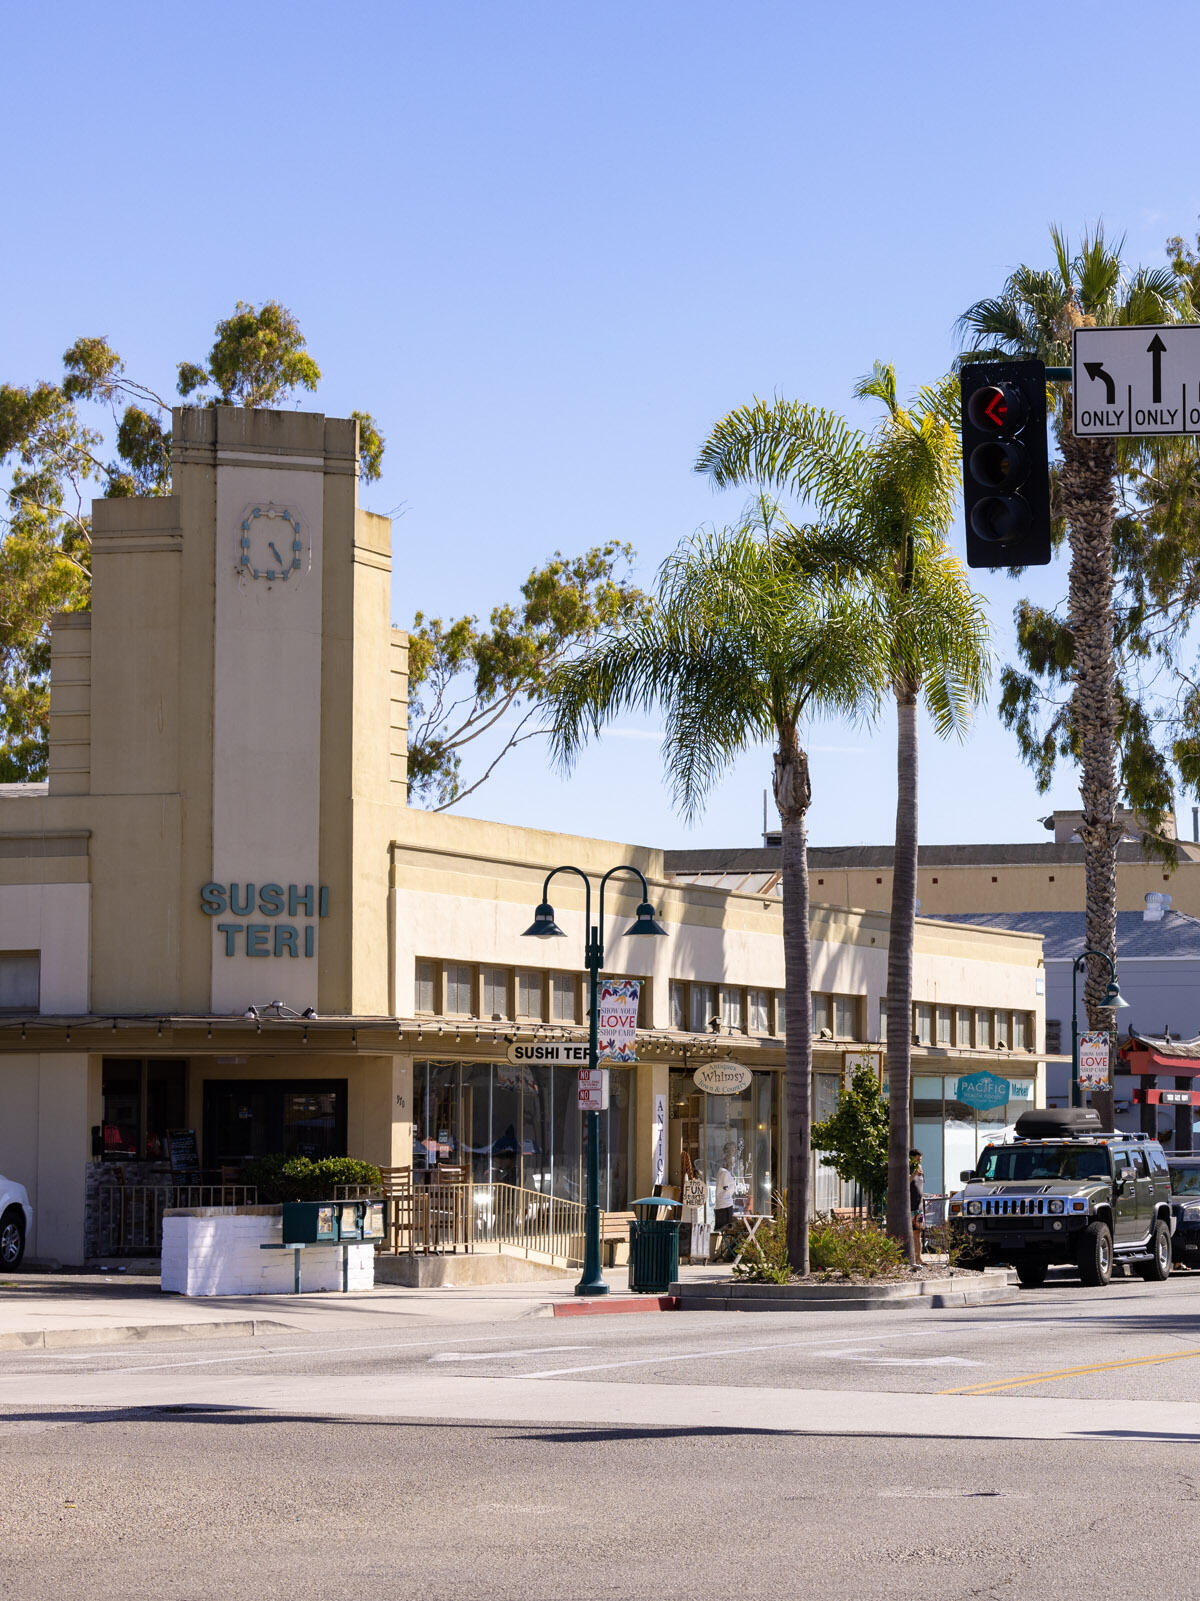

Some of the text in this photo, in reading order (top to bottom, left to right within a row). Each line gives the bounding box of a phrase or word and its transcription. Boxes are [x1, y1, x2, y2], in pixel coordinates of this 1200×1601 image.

[1081, 410, 1124, 427] ONLY
[1135, 409, 1178, 426] ONLY
[201, 883, 329, 917] SUSHI
[218, 924, 314, 958] TERI
[601, 1015, 635, 1028] LOVE
[515, 1046, 559, 1060] SUSHI
[1080, 1056, 1108, 1067] LOVE
[580, 1070, 589, 1080] NO
[702, 1070, 745, 1083] Whimsy
[961, 1080, 1006, 1095] PACIFIC
[580, 1090, 589, 1100] NO
[685, 1186, 704, 1195] FUN
